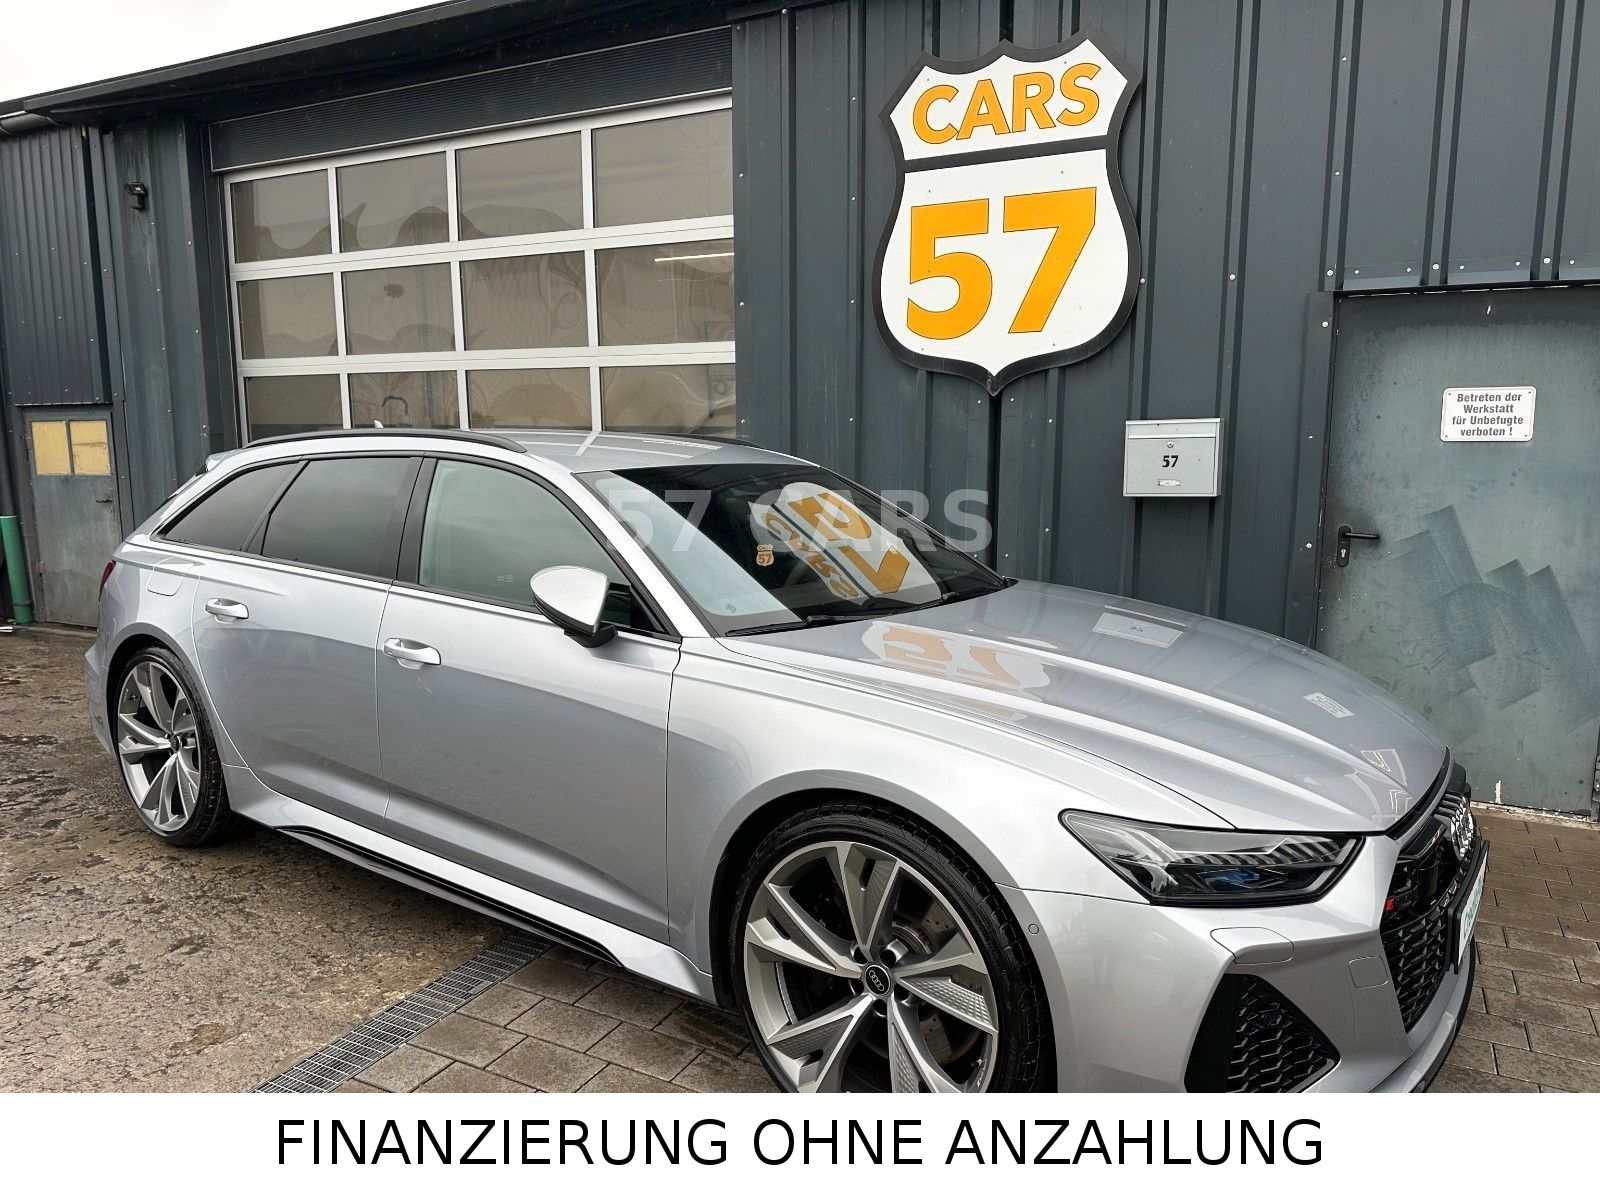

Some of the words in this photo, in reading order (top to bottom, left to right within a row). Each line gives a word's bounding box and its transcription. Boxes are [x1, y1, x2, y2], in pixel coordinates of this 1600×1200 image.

[912, 62, 1101, 144] CARS
[906, 187, 1097, 341] 57
[1457, 393, 1502, 402] Betreten
[1505, 392, 1523, 401] der
[1463, 404, 1514, 413] Werkstatt
[1452, 416, 1467, 425] für
[1470, 415, 1524, 426] Unbefugte
[1460, 427, 1506, 436] verboten
[1162, 455, 1179, 468] 57
[758, 553, 772, 564] 57
